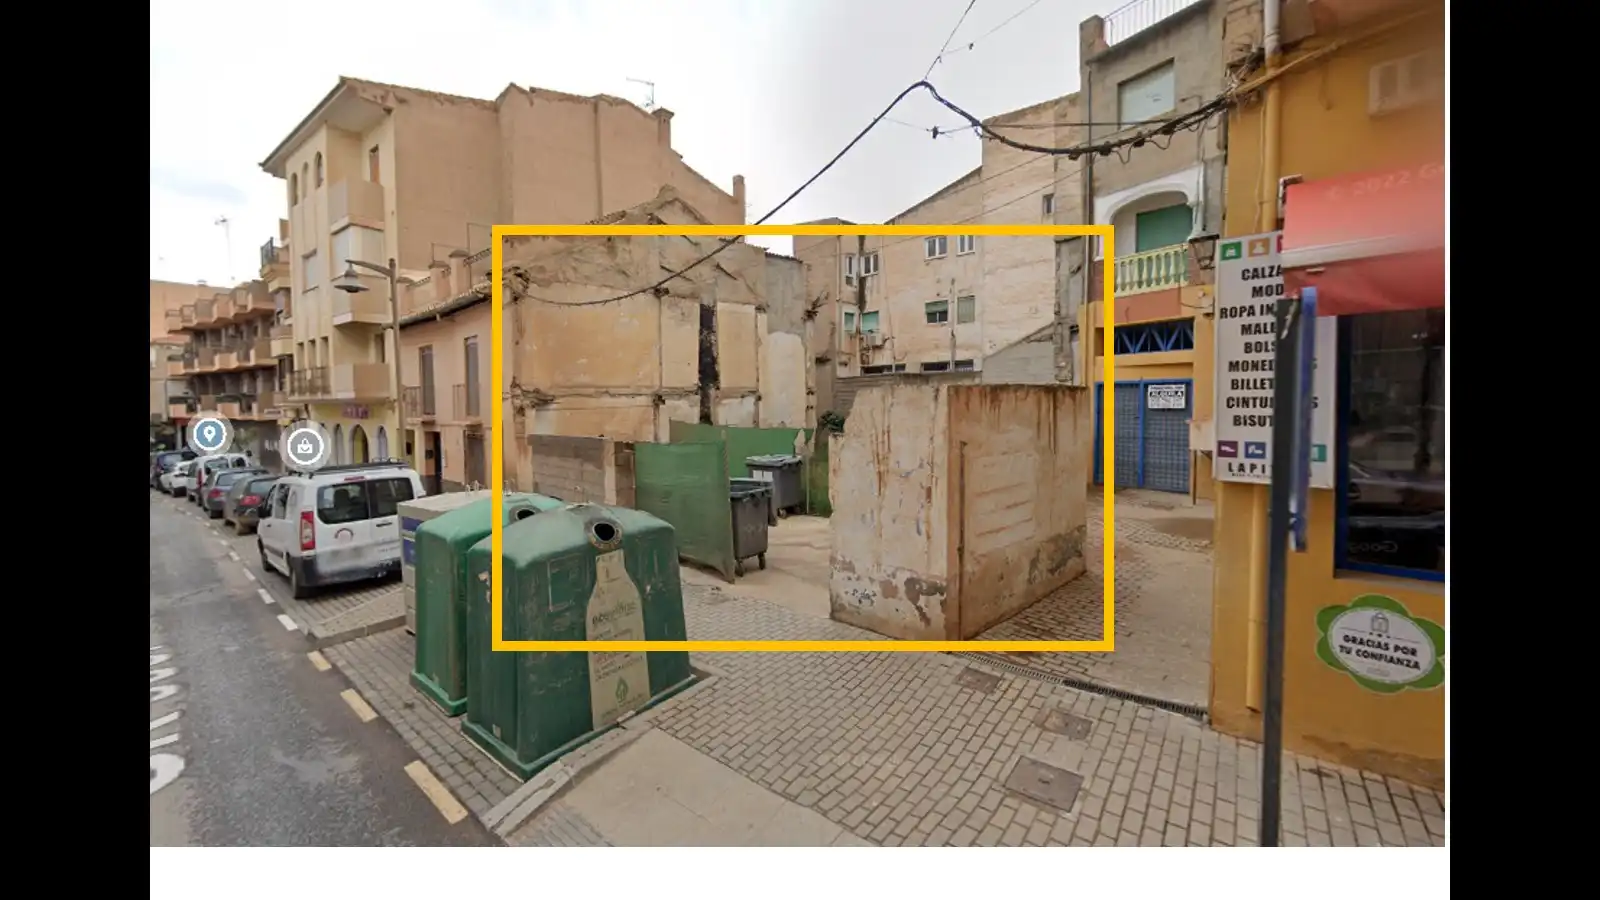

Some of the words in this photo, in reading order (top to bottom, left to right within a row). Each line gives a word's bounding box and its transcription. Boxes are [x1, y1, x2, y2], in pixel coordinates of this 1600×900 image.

[1241, 264, 1283, 281] CALZA
[1251, 283, 1284, 298] MOD
[1220, 305, 1256, 319] ROPA
[1240, 322, 1276, 336] MALE
[1244, 341, 1276, 353] BOLS
[1231, 378, 1275, 391] BILLET
[1233, 414, 1274, 427] BISUT
[1343, 634, 1390, 651] GRACIAS
[1393, 644, 1418, 656] POR
[1339, 645, 1352, 655] TU
[1355, 649, 1421, 670] CONFIANZA
